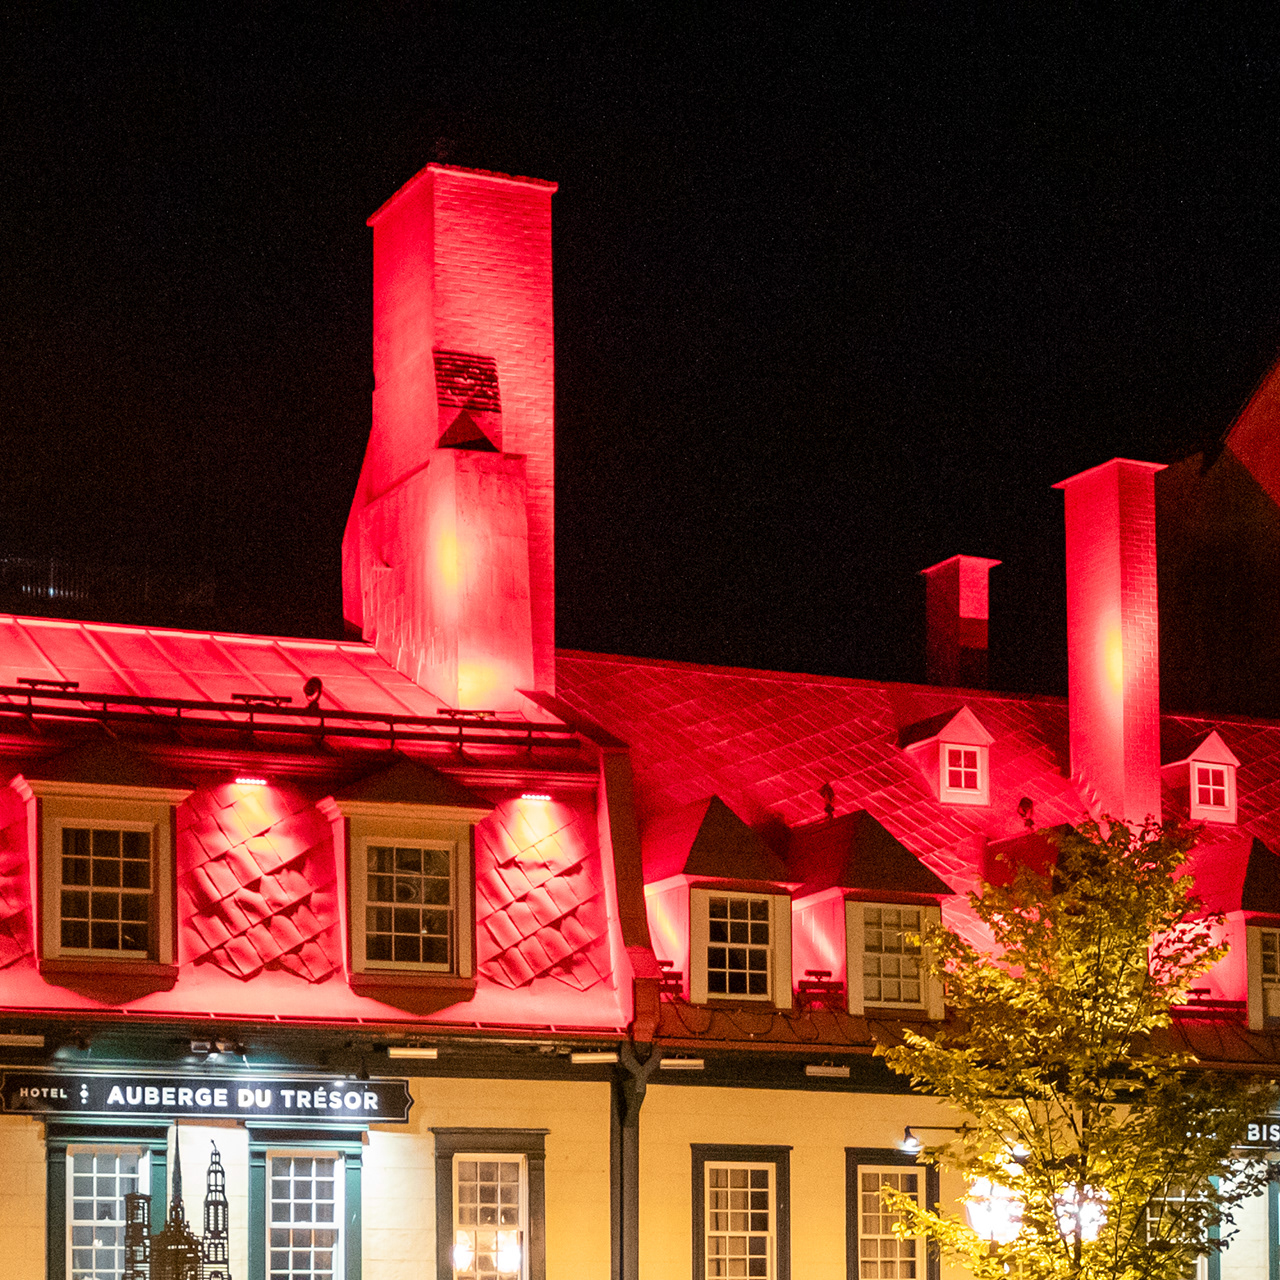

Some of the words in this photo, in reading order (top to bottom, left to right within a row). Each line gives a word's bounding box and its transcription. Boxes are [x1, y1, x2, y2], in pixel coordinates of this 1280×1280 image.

[19, 1087, 68, 1099] HOTEL
[106, 1085, 229, 1107] AUBERGE
[236, 1088, 273, 1109] DU
[280, 1086, 380, 1110] TRÉSOR
